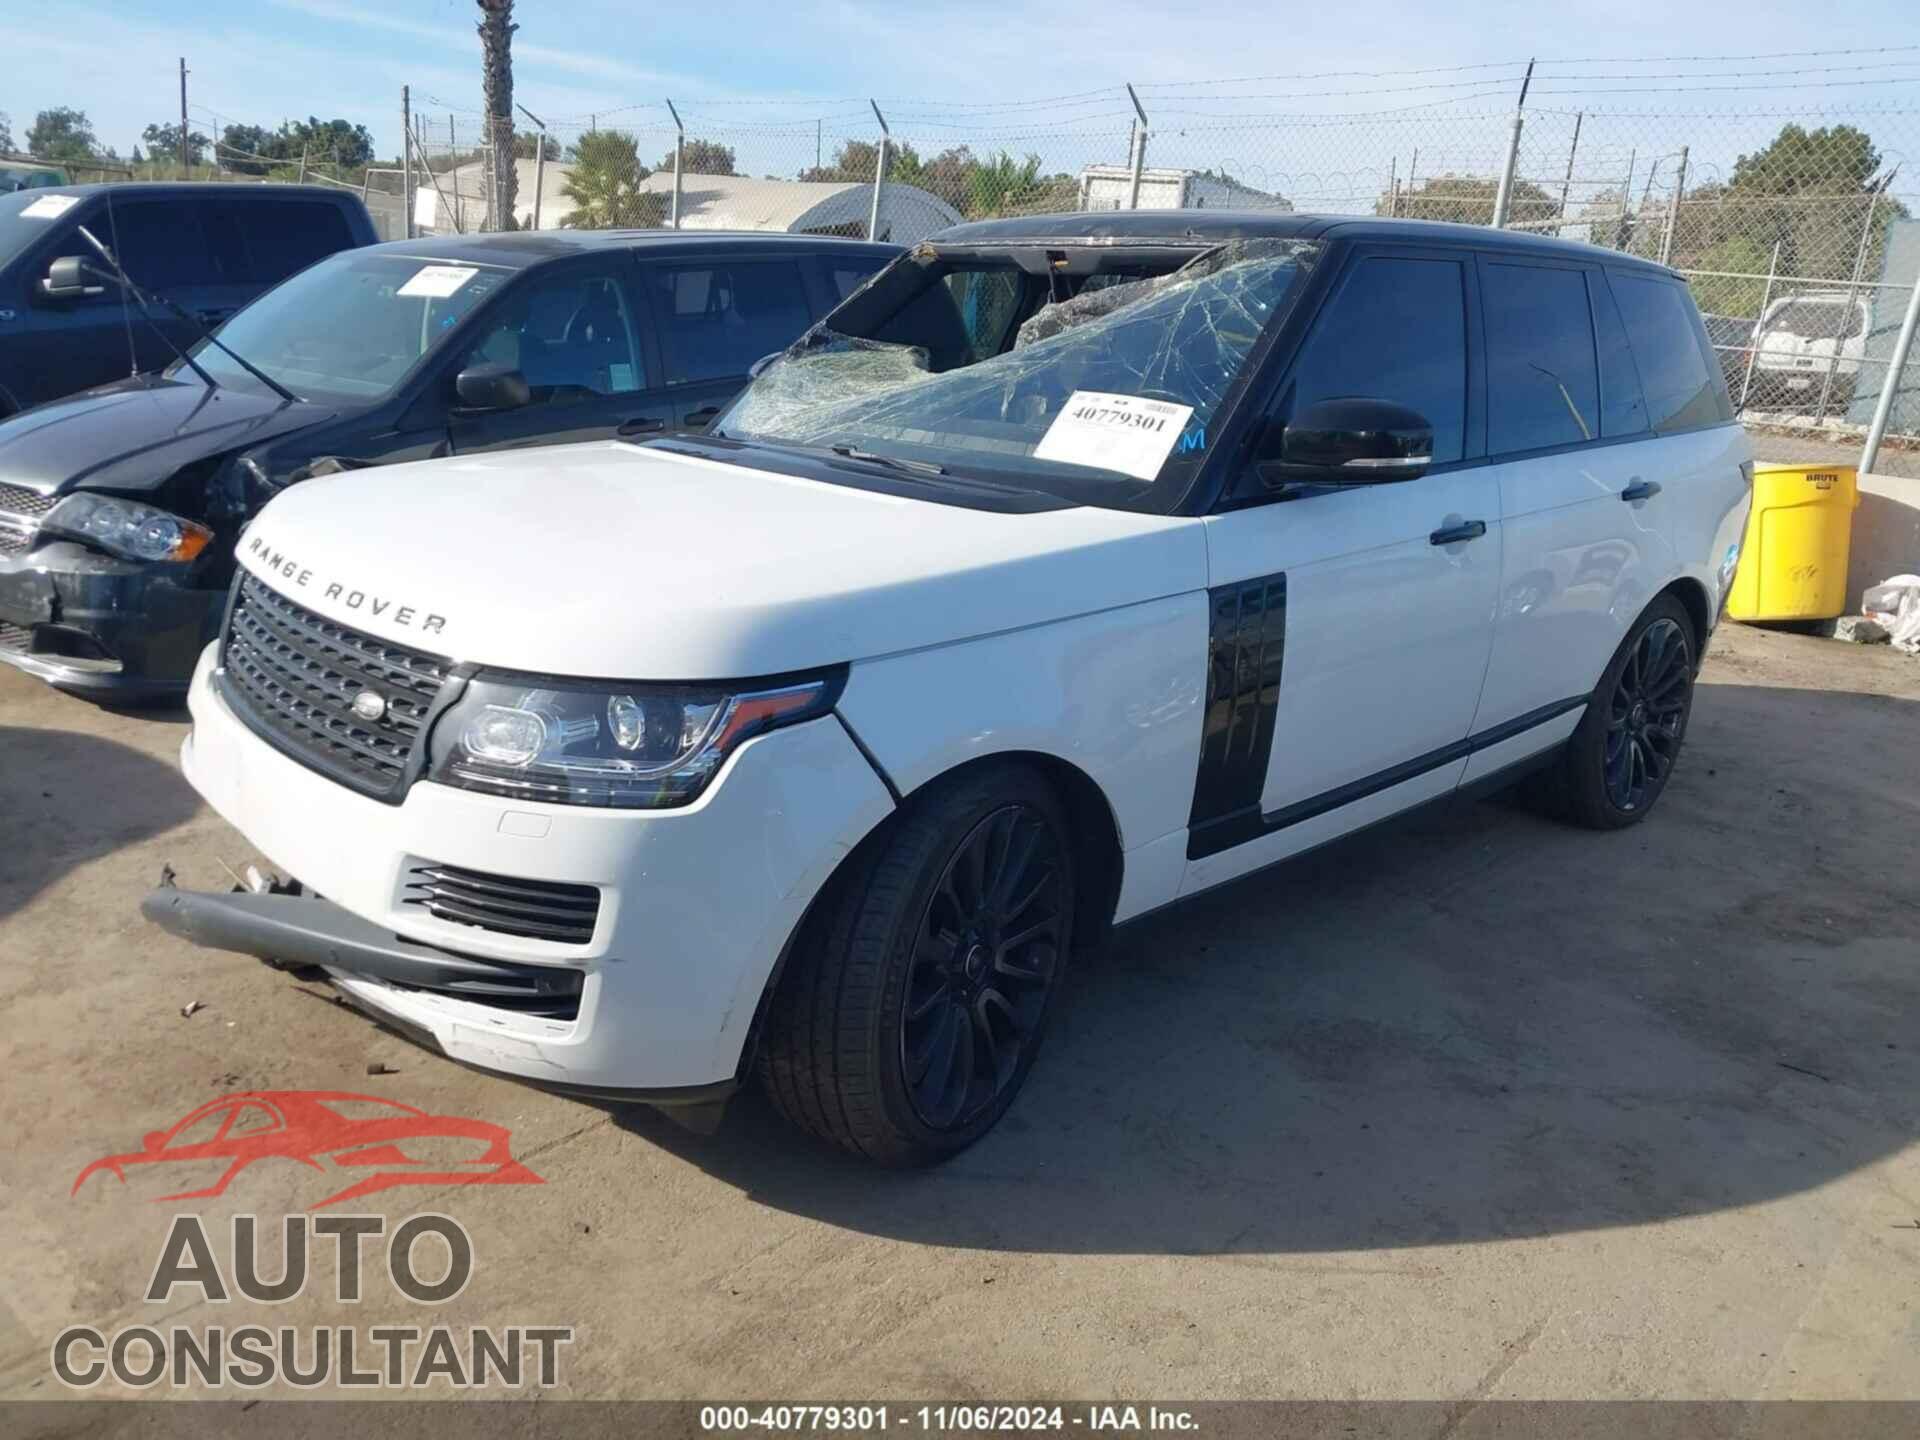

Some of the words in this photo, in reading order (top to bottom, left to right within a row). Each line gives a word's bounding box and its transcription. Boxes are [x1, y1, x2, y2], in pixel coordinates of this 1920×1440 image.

[1072, 406, 1167, 432] 40779301
[249, 537, 313, 586] RANGE
[323, 582, 447, 635] ROVER
